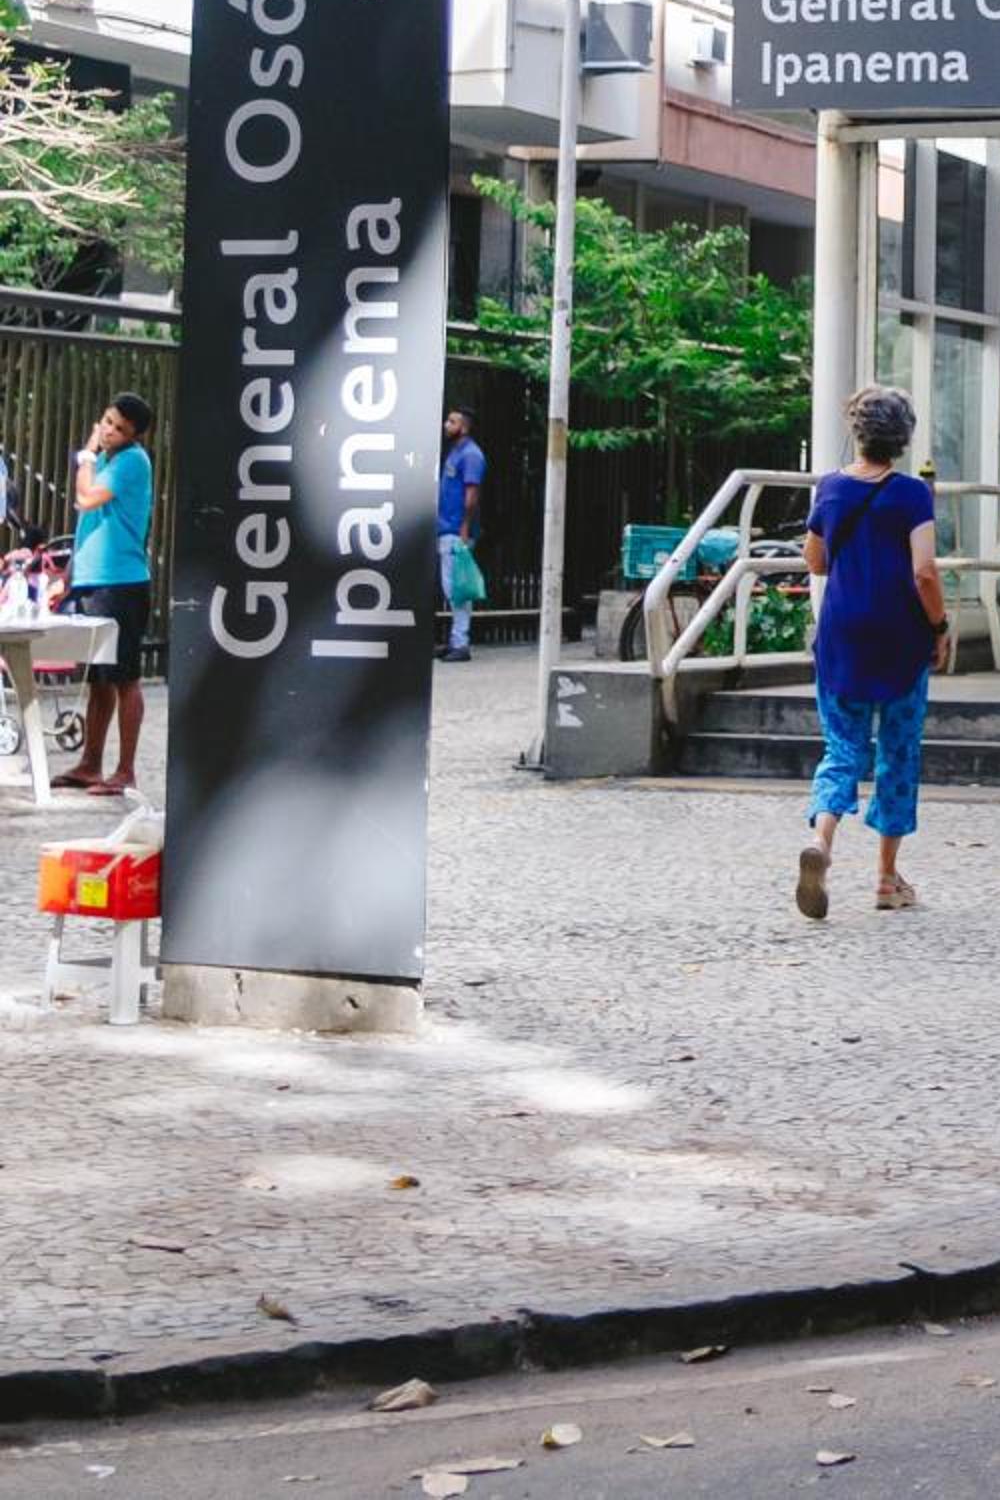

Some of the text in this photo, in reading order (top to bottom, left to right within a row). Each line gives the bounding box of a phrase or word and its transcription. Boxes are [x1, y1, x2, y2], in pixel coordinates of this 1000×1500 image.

[760, 42, 969, 97] Ipanema
[210, 229, 299, 660] General
[310, 197, 416, 658] Ipanema
